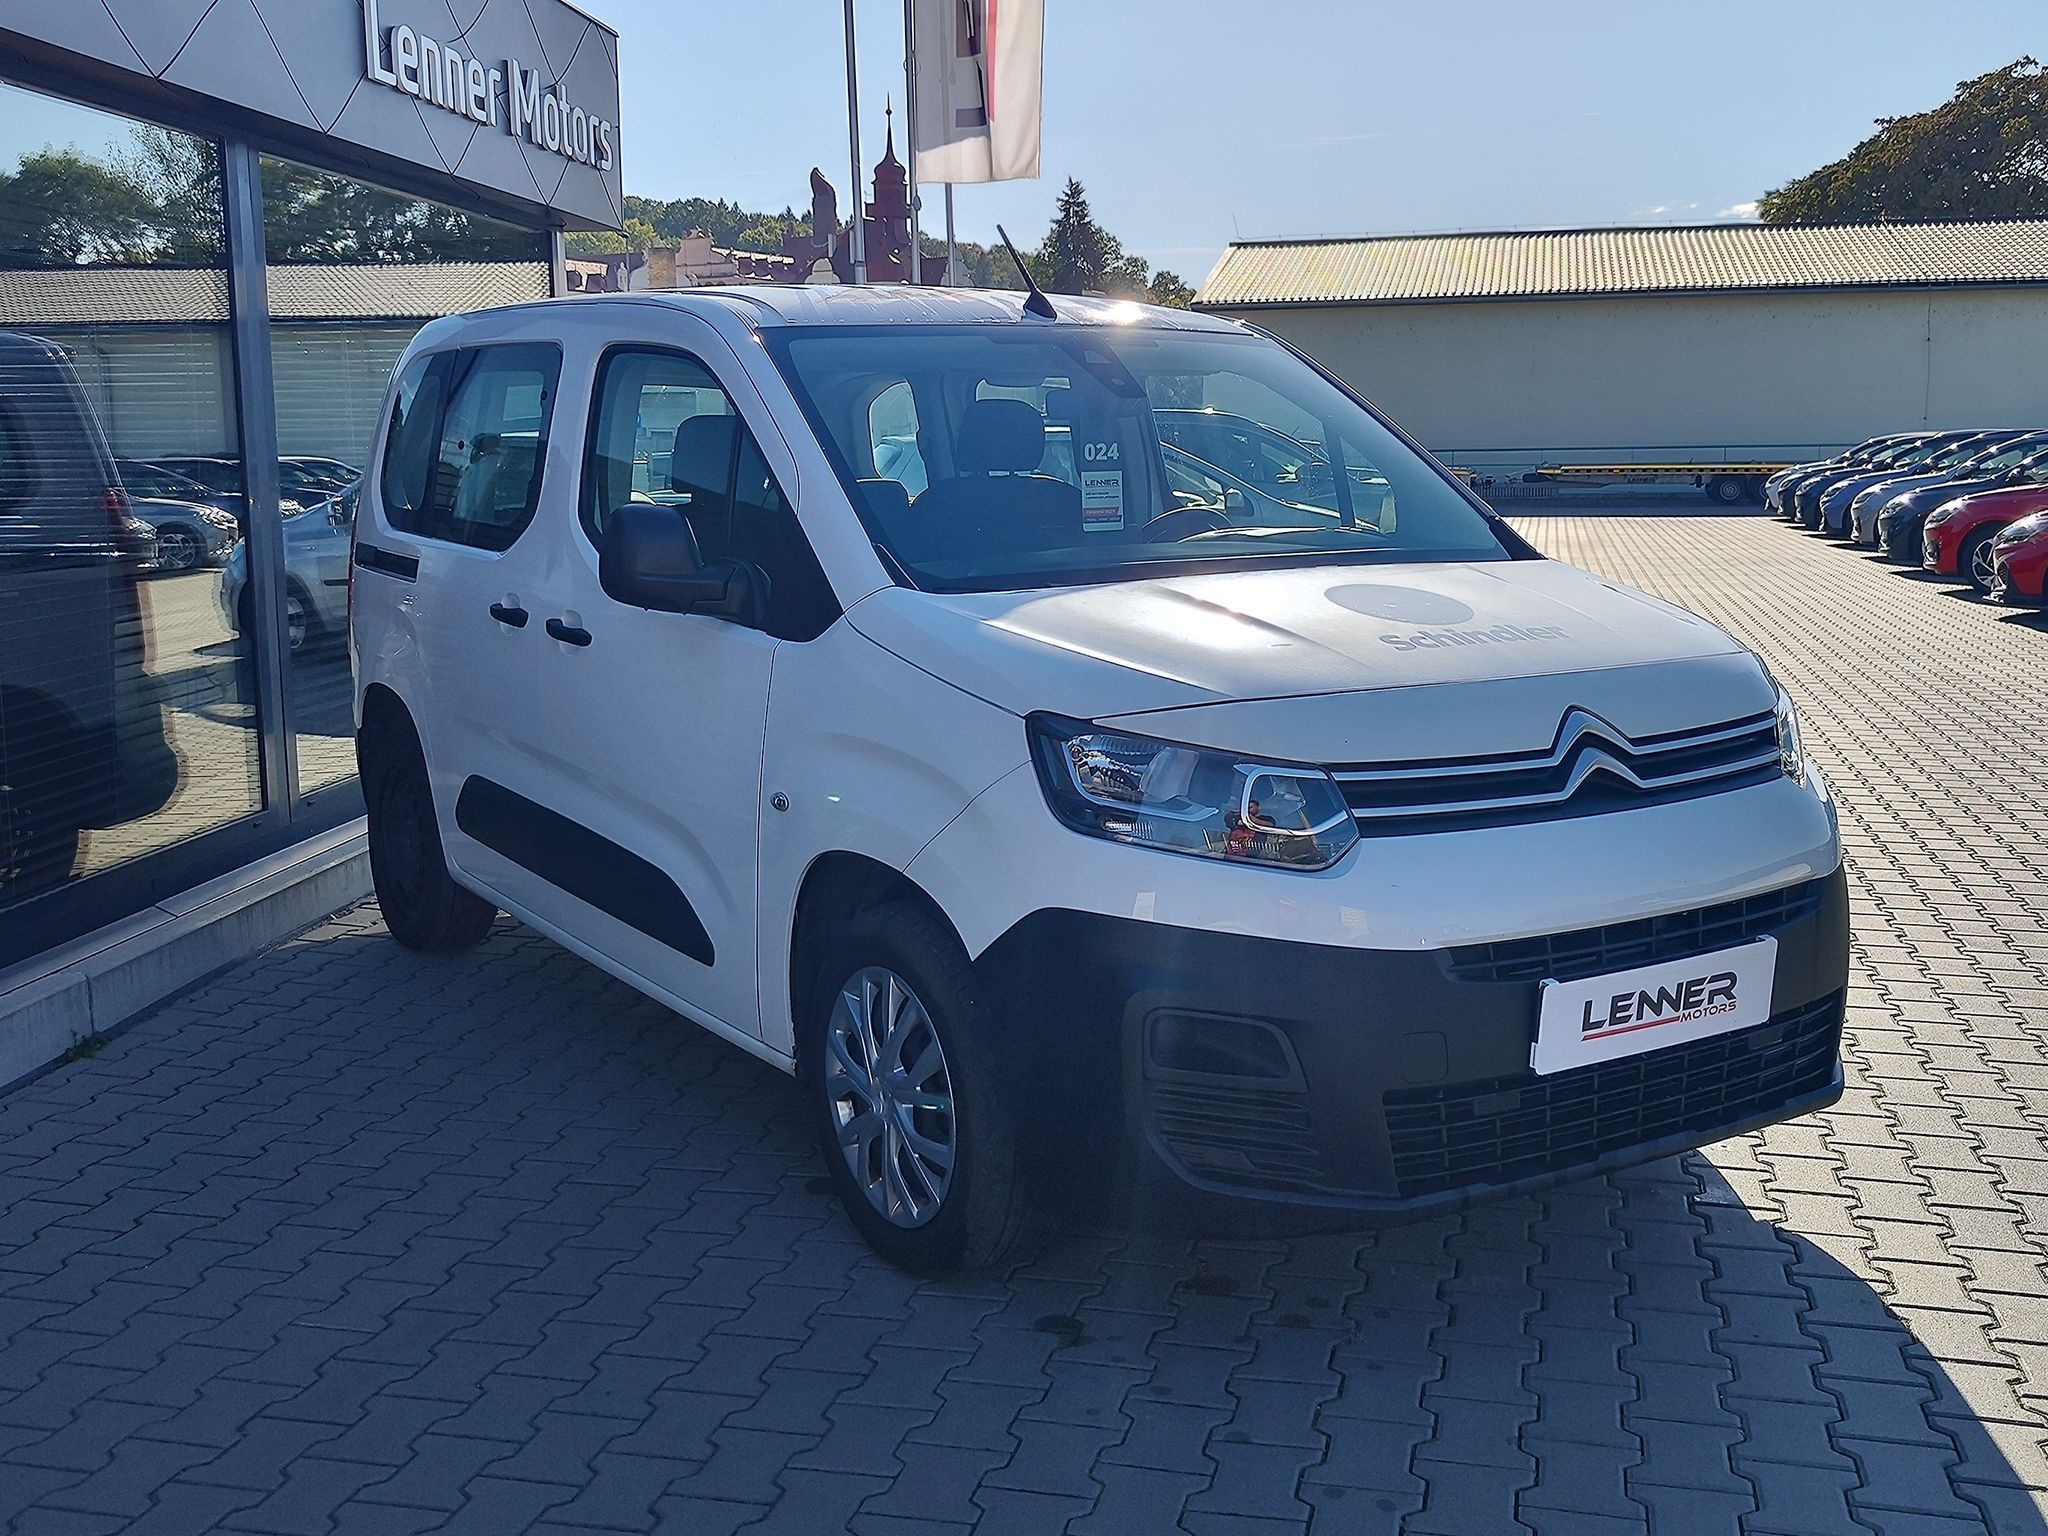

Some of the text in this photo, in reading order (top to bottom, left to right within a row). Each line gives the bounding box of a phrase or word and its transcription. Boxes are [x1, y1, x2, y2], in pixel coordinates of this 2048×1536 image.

[364, 0, 613, 171] Lenner Motors
[1084, 442, 1120, 461] 024
[1084, 479, 1120, 487] LENNER
[1379, 623, 1570, 651] Schindler
[1581, 971, 1739, 1032] LENNER
[1679, 1000, 1738, 1023] MOTORS
